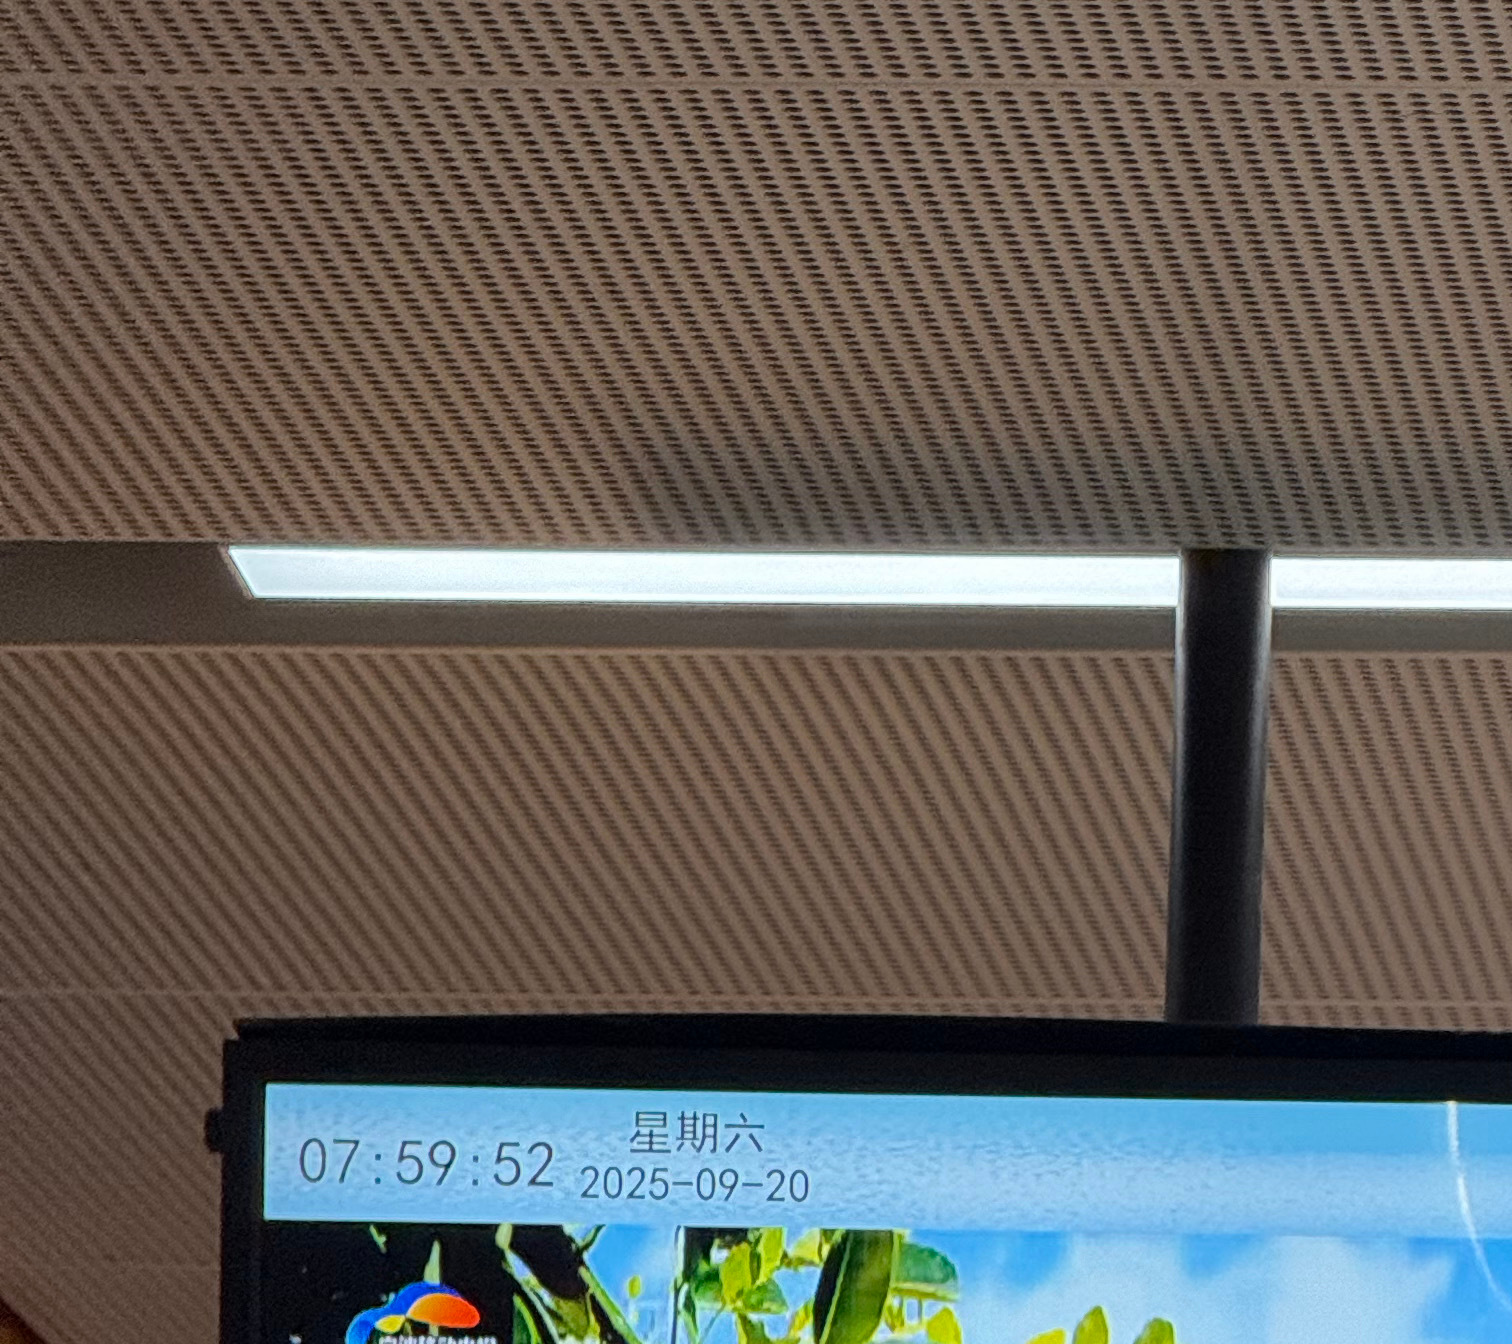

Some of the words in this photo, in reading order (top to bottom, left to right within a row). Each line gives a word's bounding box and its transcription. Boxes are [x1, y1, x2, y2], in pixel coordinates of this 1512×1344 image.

[630, 1111, 765, 1153] 星期六
[299, 1138, 553, 1187] 07:59:52
[580, 1166, 809, 1204] 2025-09-20
